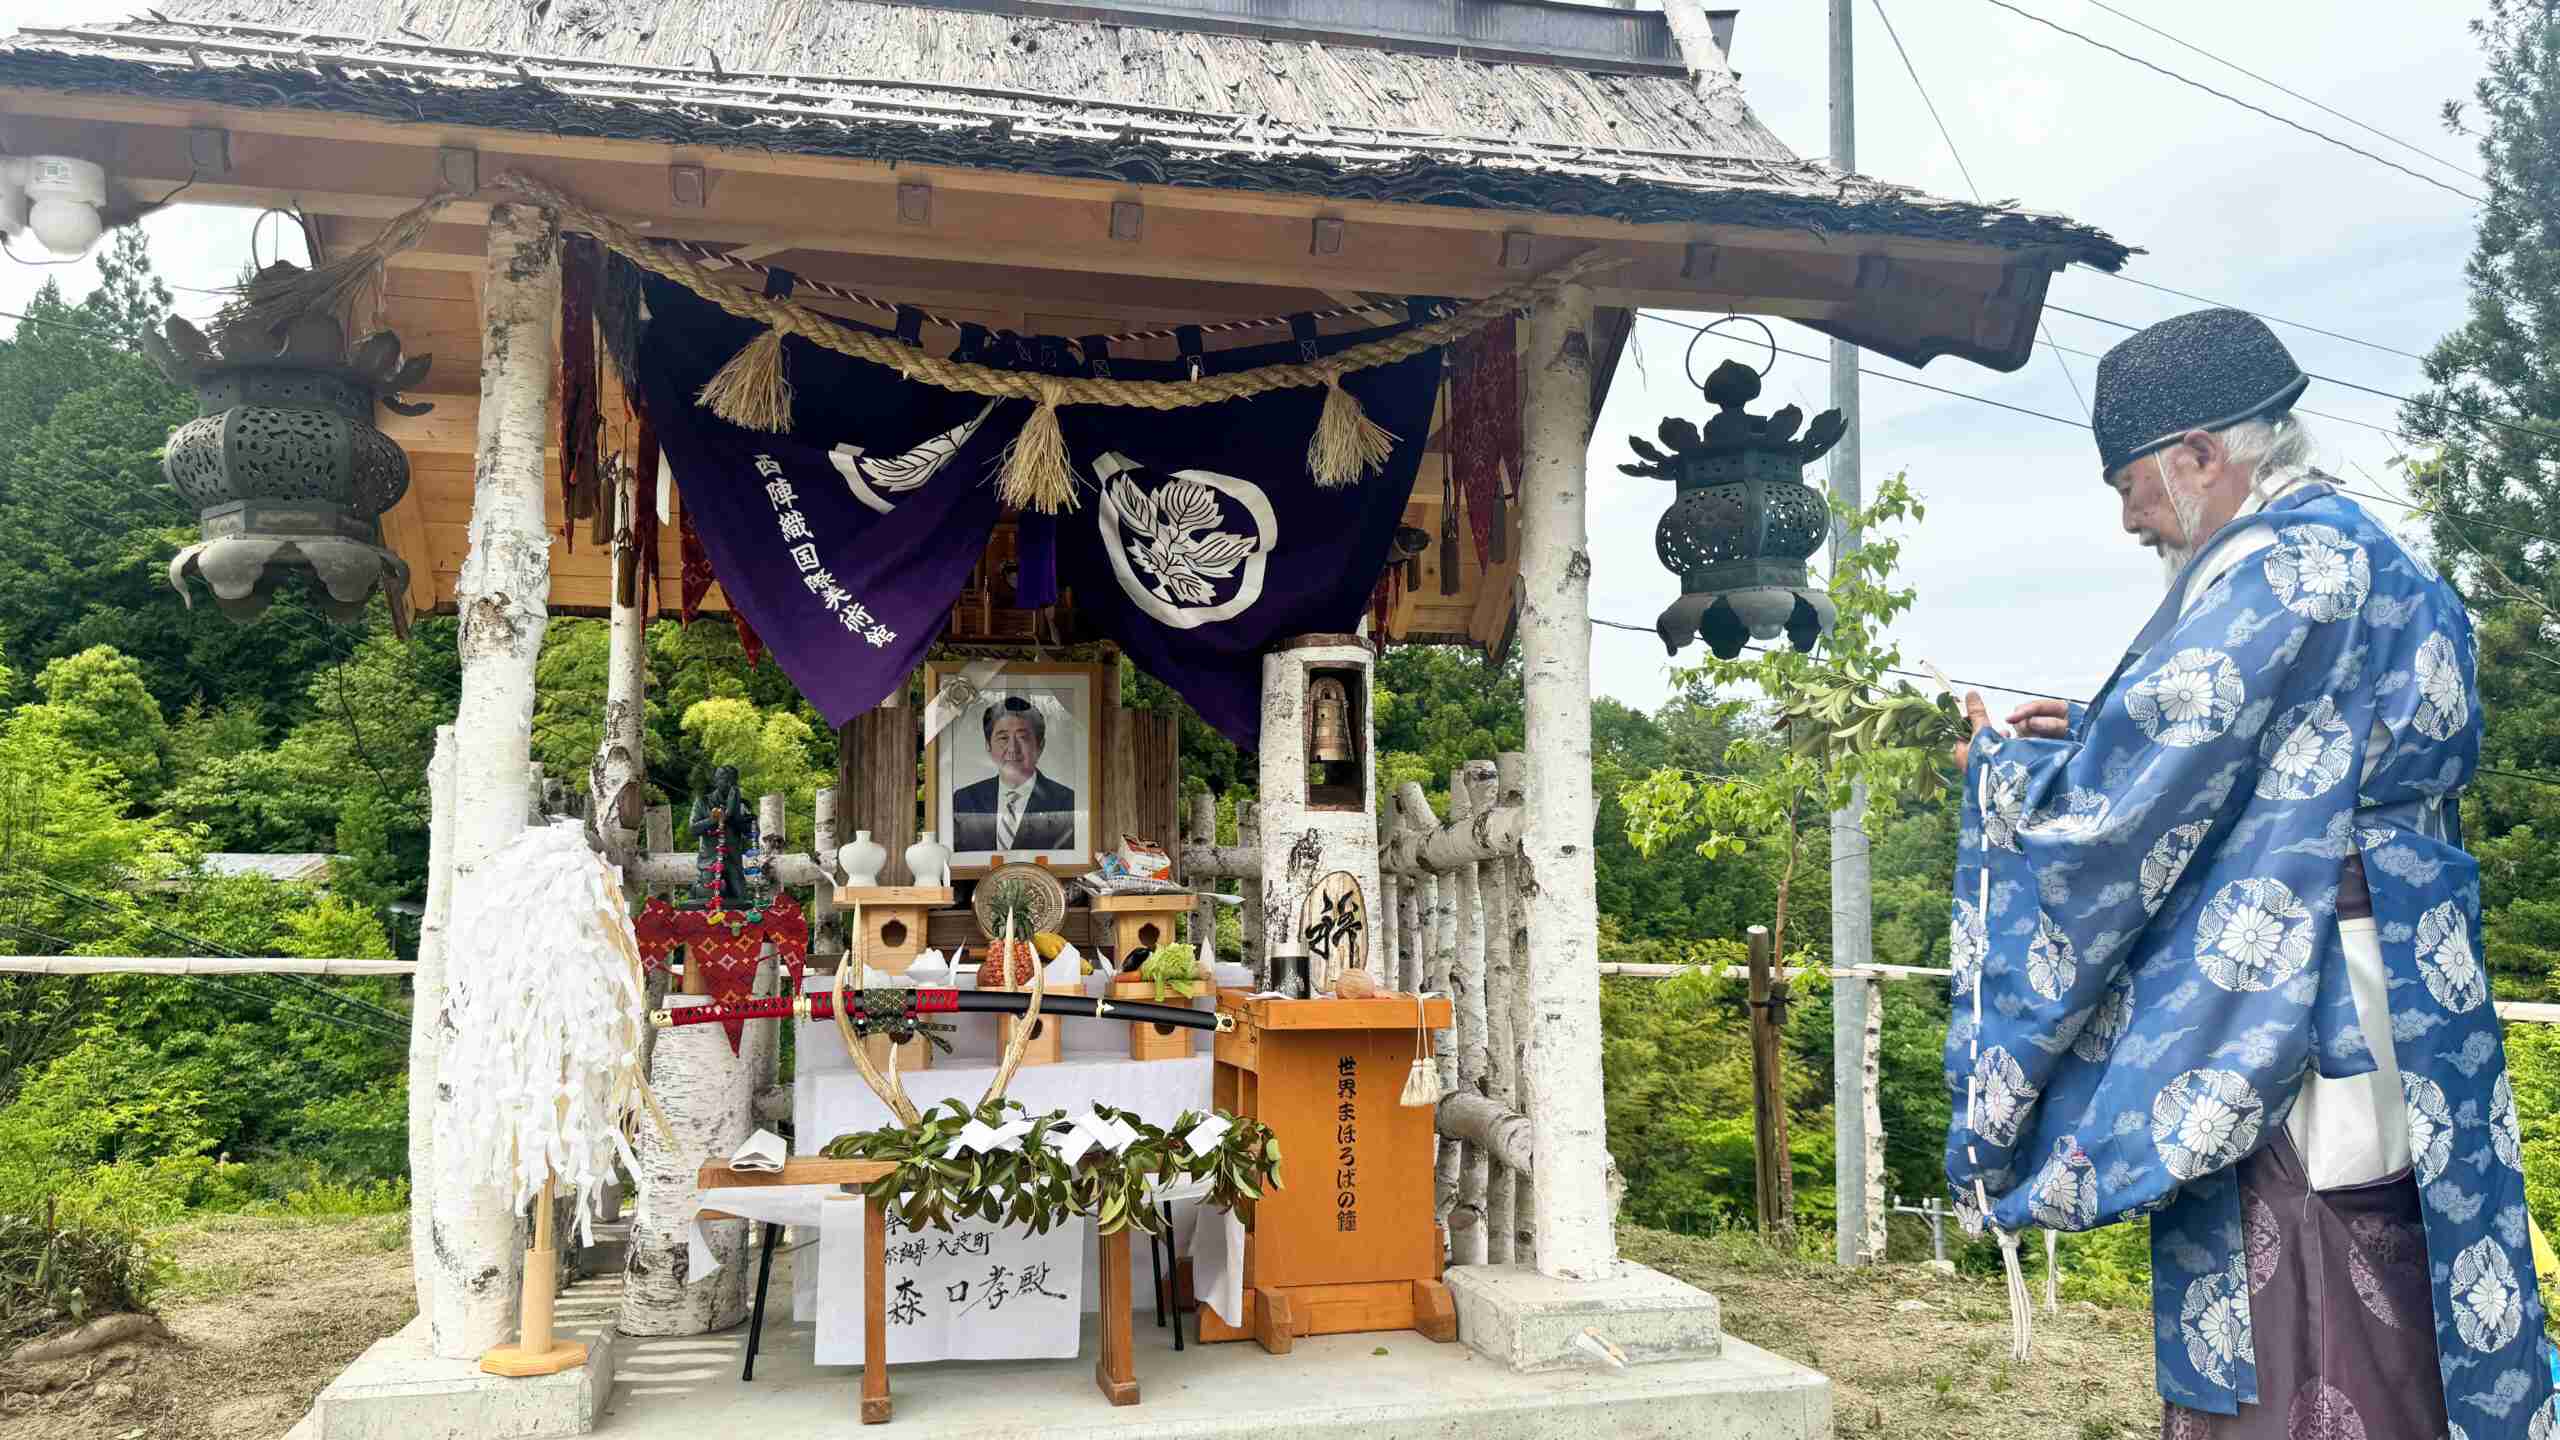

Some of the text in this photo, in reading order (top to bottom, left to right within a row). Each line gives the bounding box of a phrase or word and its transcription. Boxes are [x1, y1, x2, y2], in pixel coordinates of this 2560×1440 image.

[754, 454, 896, 648] 西陣織国際美術館
[1336, 1056, 1358, 1232] 世界まほろばの鐘
